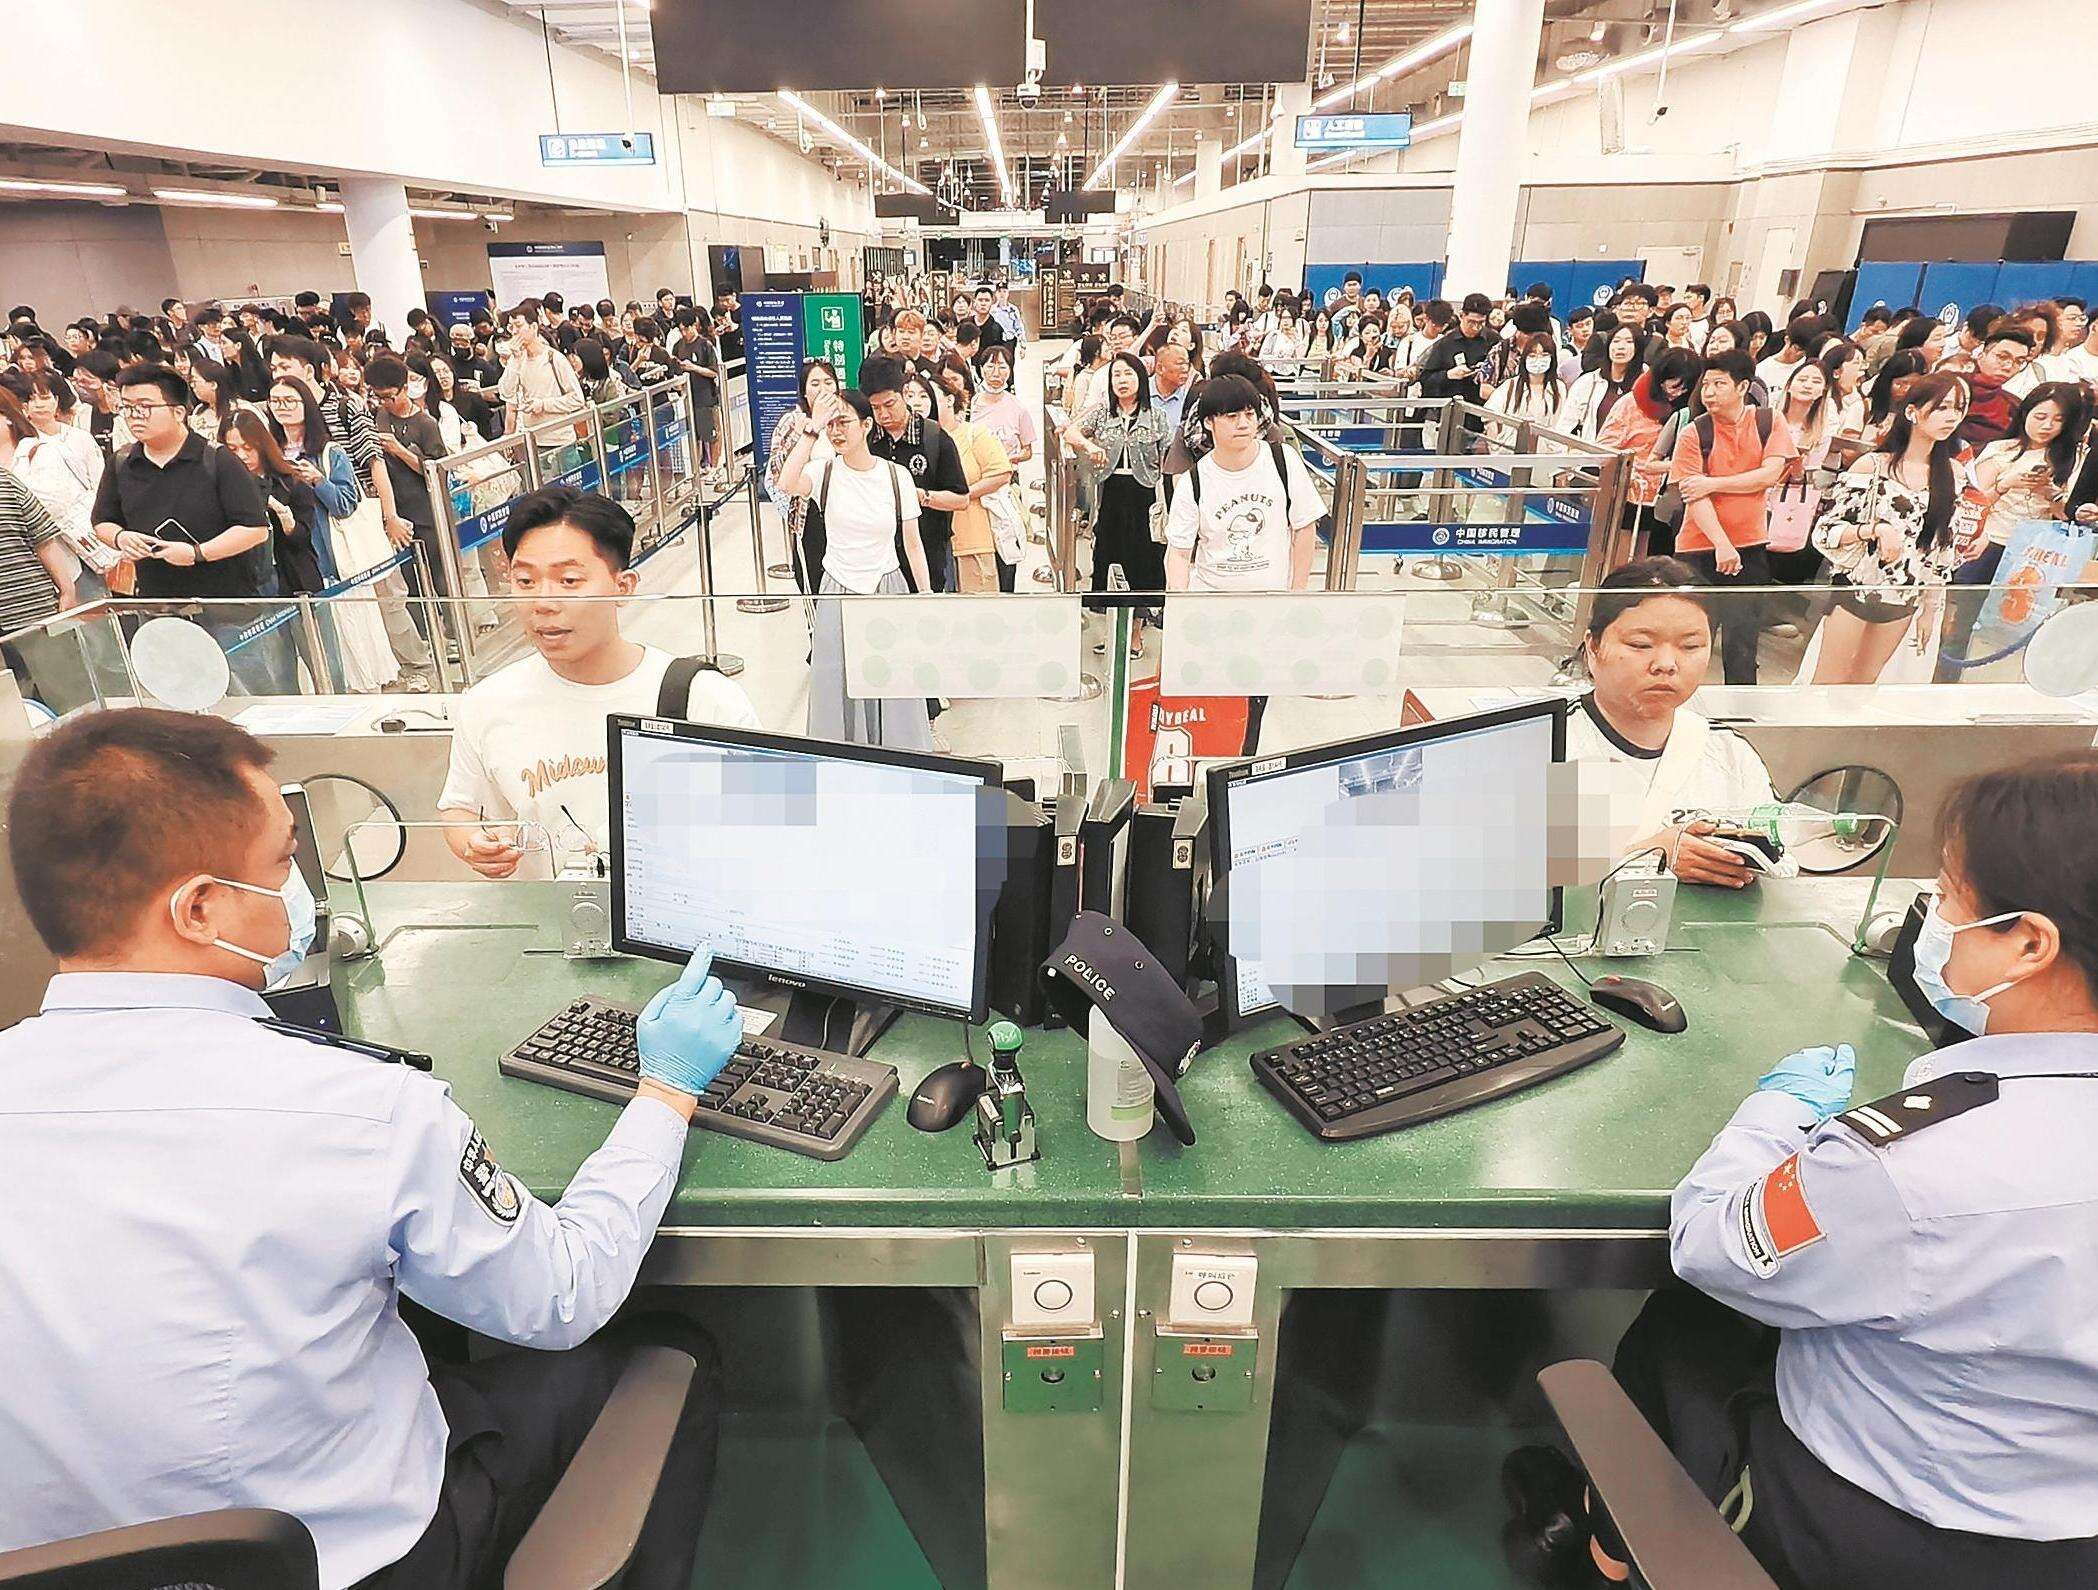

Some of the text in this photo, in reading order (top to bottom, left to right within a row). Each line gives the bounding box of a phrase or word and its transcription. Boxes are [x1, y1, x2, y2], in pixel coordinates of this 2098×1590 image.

[1215, 493, 1274, 520] PEANUTS
[1455, 527, 1521, 539] 中国移民管理
[768, 973, 806, 988] lenovo
[1063, 954, 1116, 1001] POLICE
